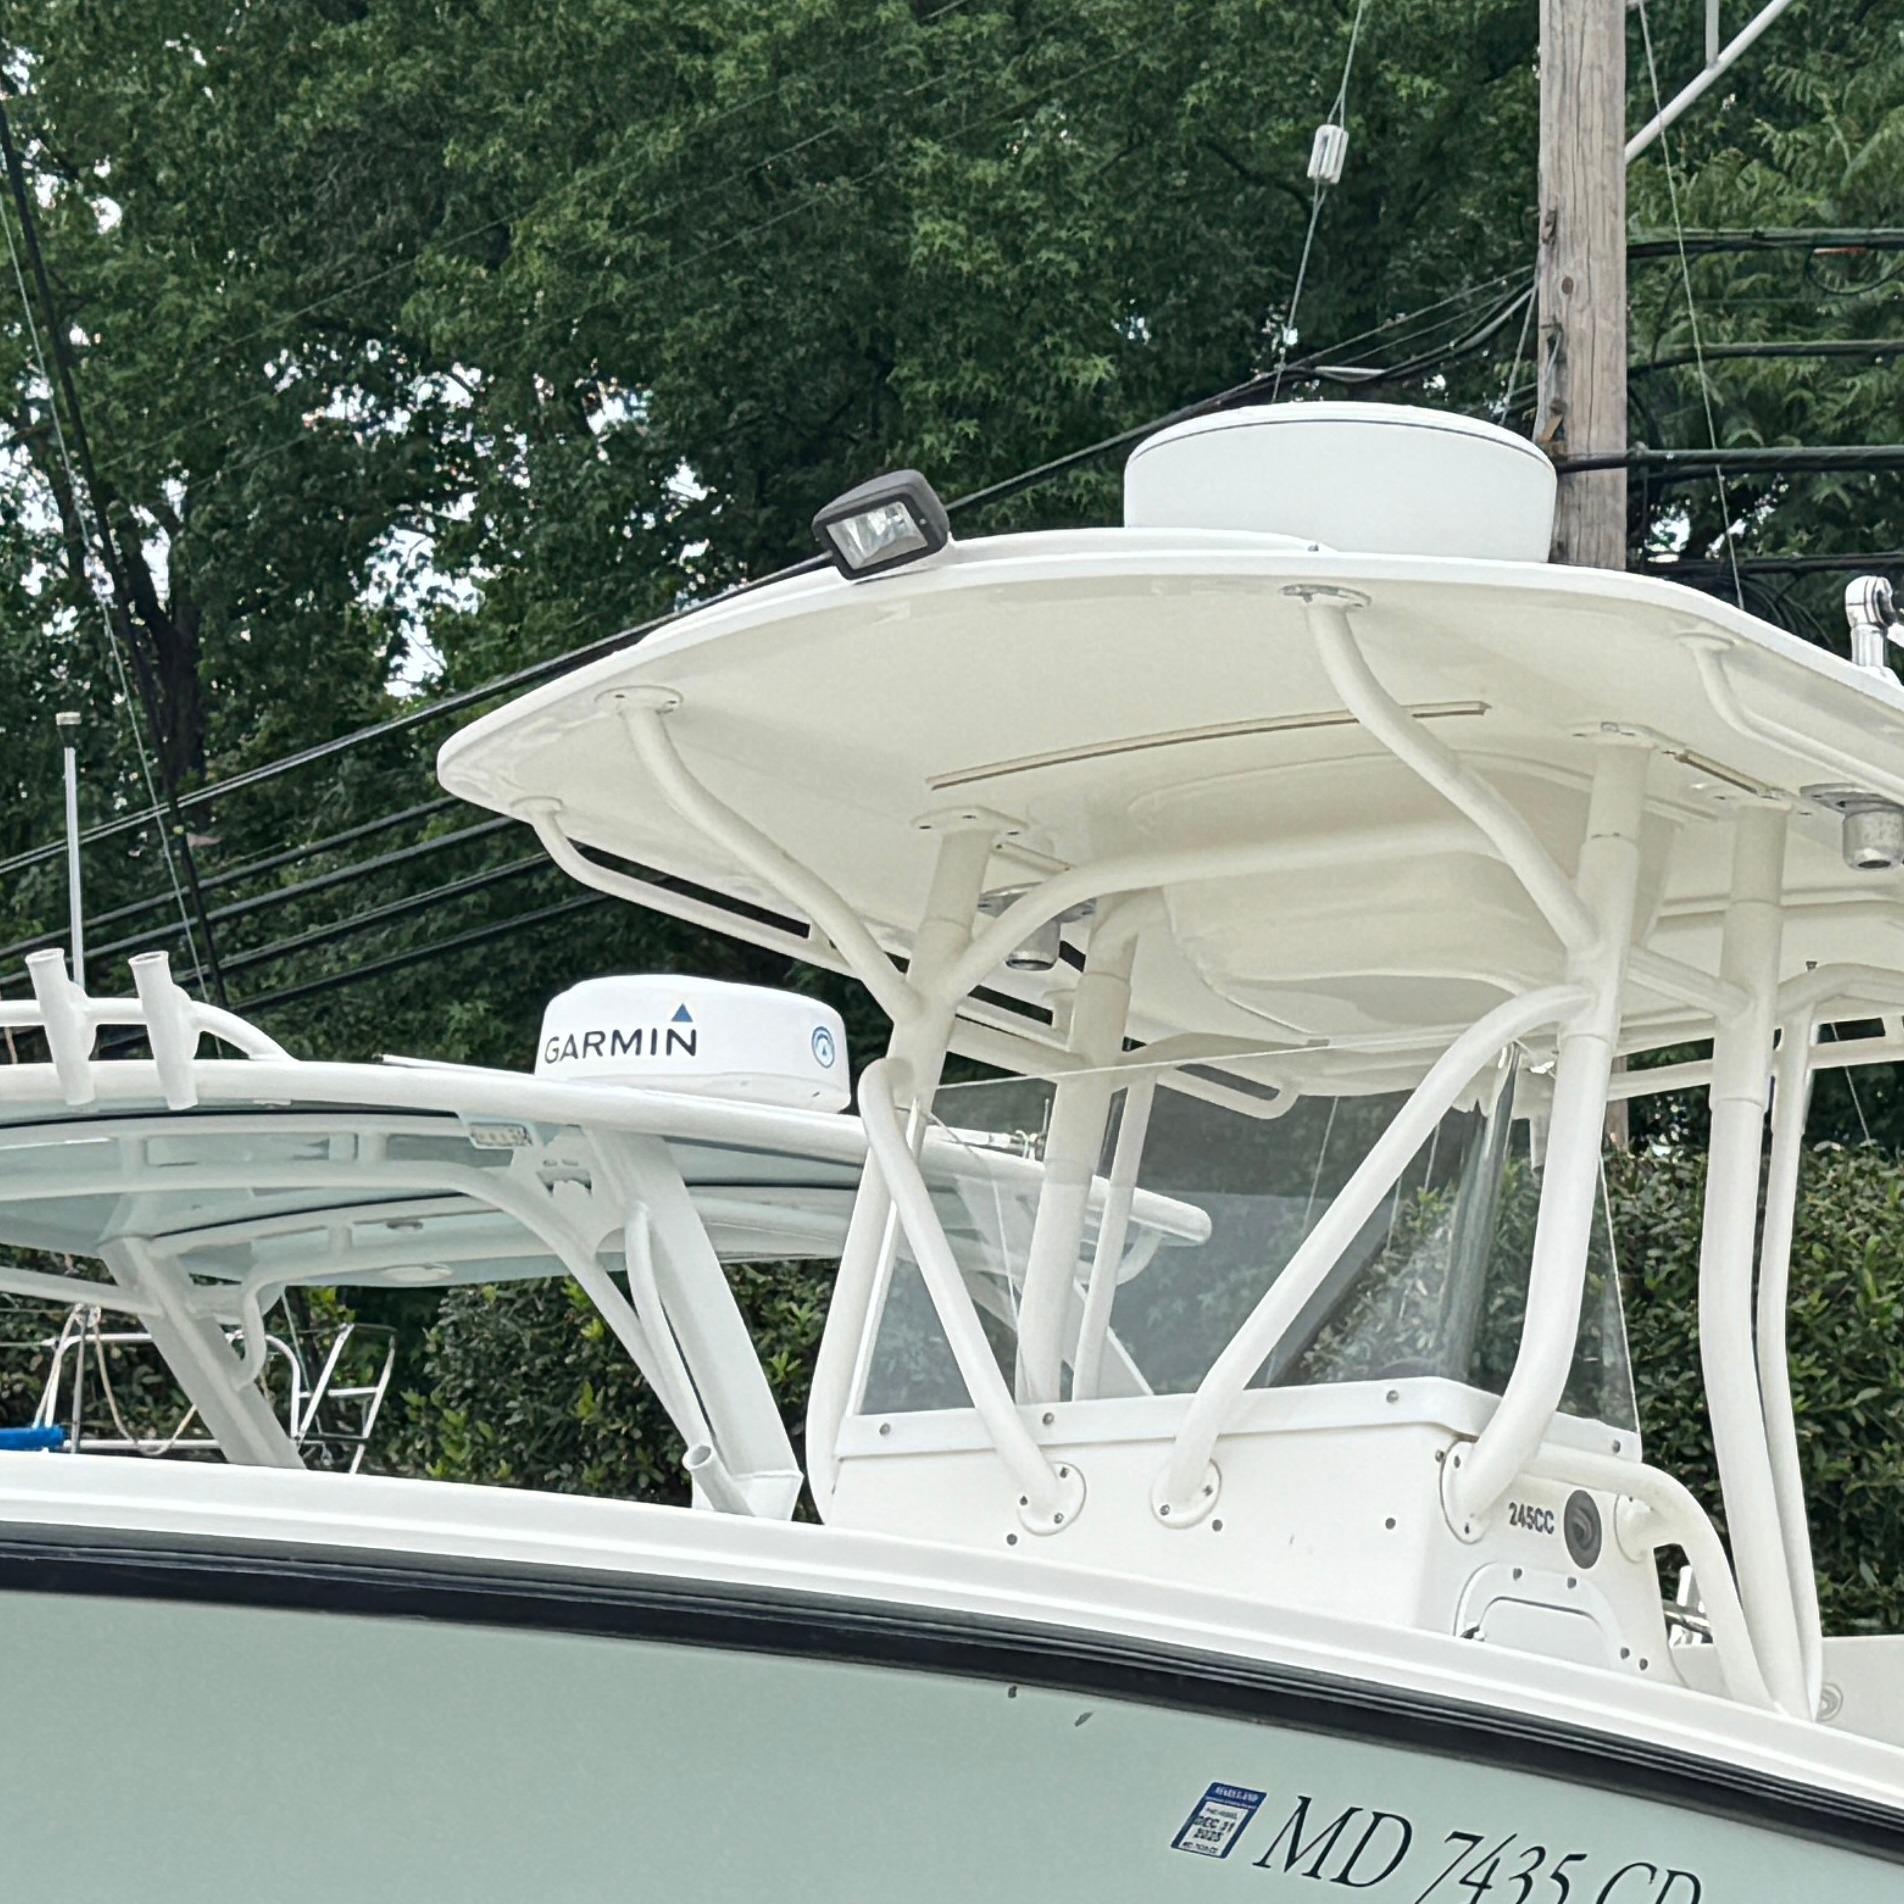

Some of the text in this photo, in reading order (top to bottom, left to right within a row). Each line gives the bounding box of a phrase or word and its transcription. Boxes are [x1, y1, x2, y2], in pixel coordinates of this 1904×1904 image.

[544, 1027, 698, 1065] GARMIN
[1508, 1502, 1555, 1534] 245CC
[1251, 1795, 1411, 1889] MD
